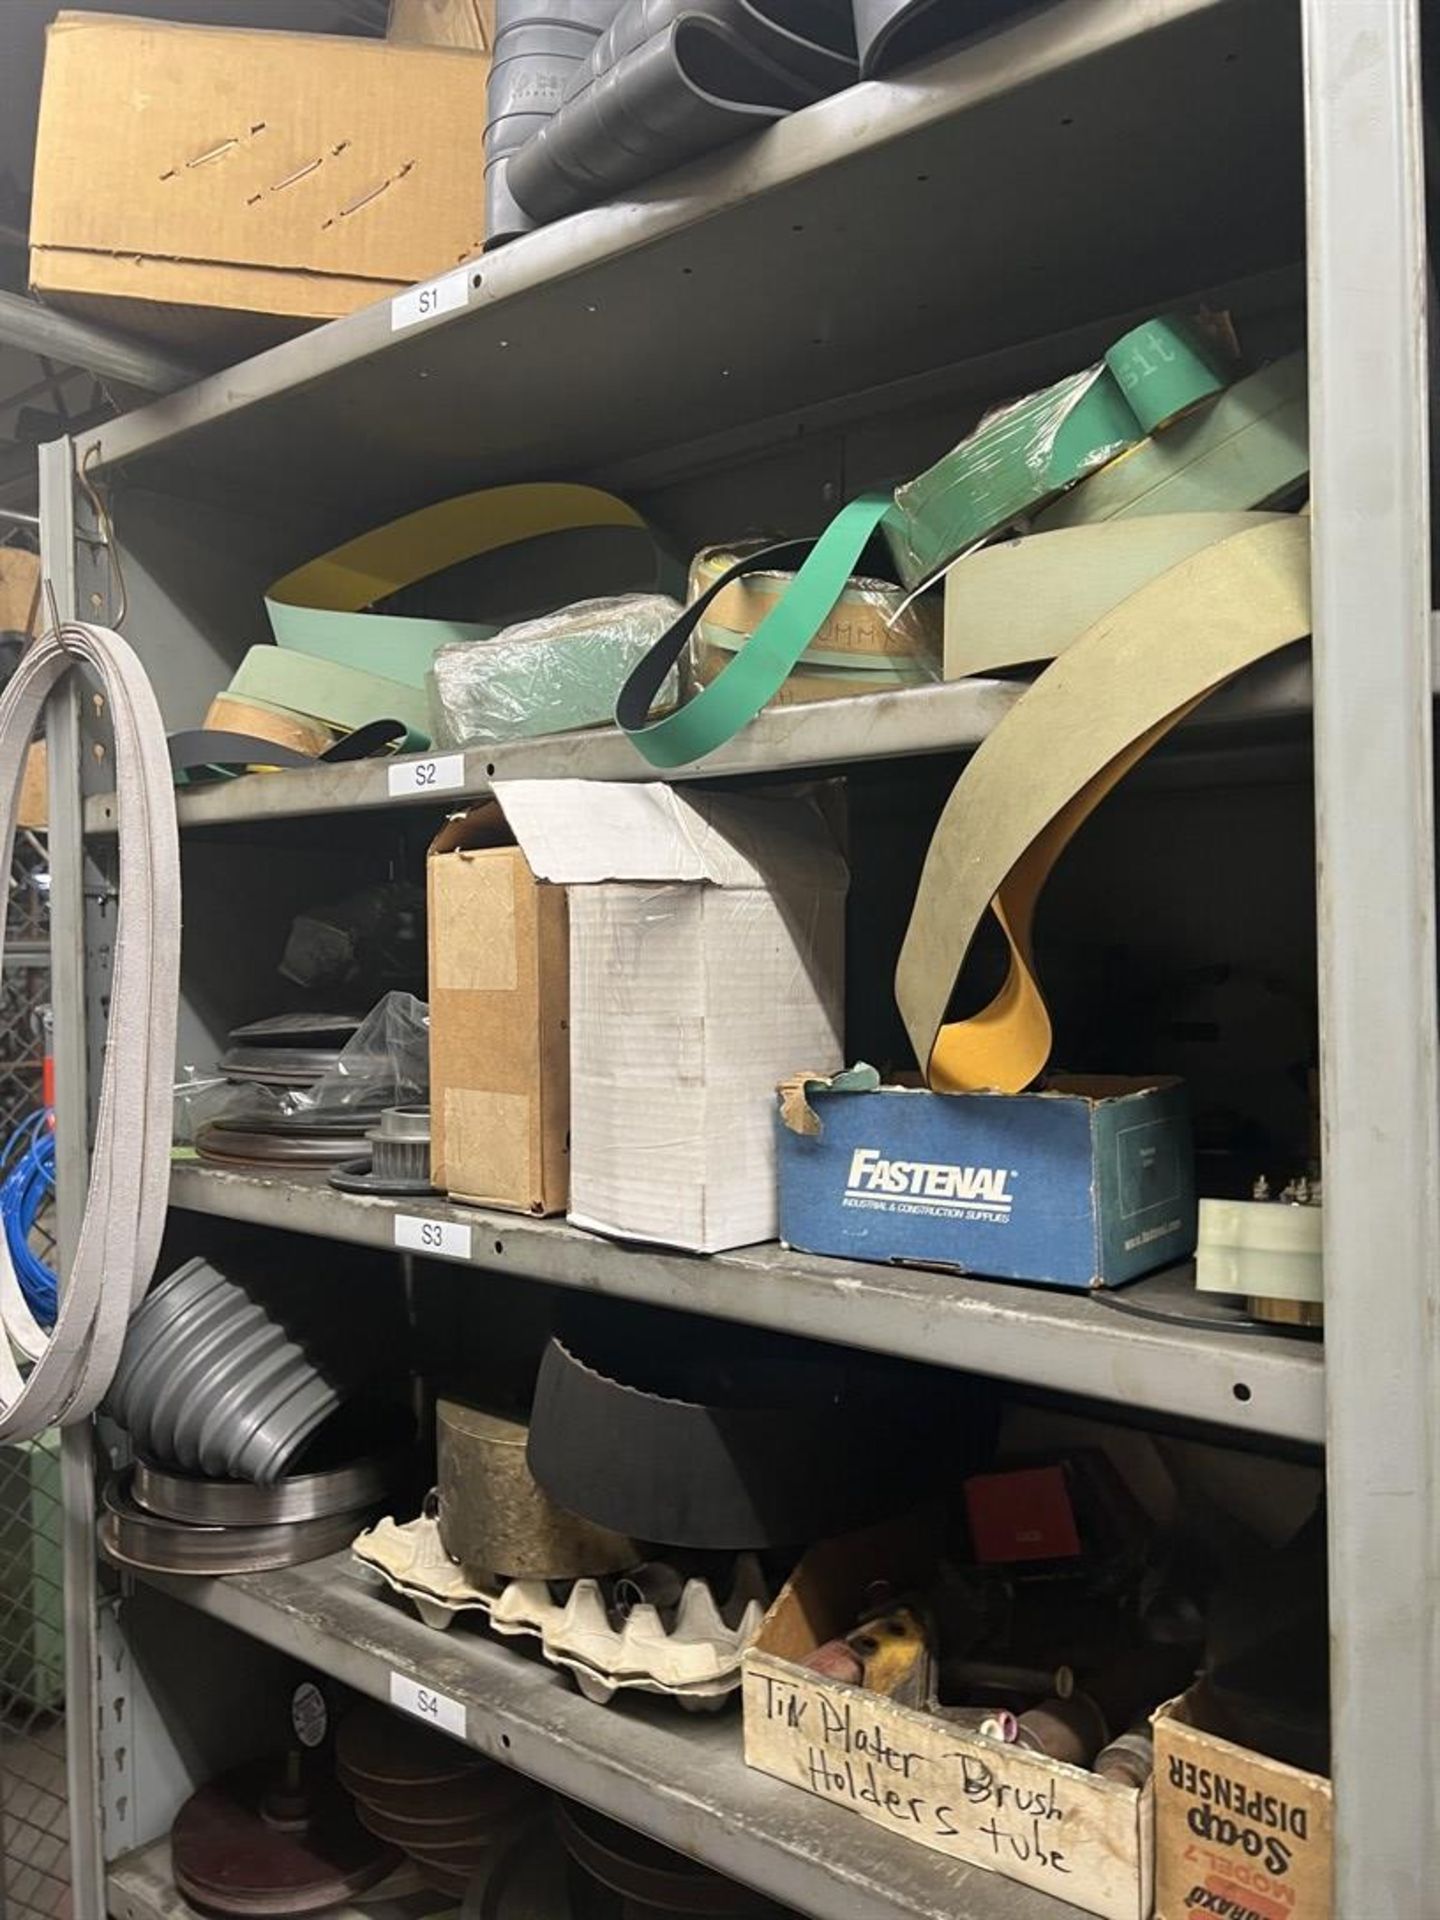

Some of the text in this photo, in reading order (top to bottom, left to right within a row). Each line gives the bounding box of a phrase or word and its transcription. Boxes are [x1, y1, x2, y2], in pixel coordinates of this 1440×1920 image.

[419, 288, 438, 313] S1
[415, 763, 437, 786] S2
[842, 1197, 1010, 1225] INDUSTRIAL & CONSTRUCTION SUPPLIES
[421, 1224, 443, 1247] S3
[417, 1690, 439, 1717] S4
[816, 1691, 927, 1778] Plater
[942, 1752, 1063, 1821] Brush
[809, 1747, 960, 1836] Holders
[1168, 1755, 1308, 1841] DISPENSER
[1187, 1803, 1293, 1876] Soap
[1184, 1844, 1296, 1907] MODEL 7
